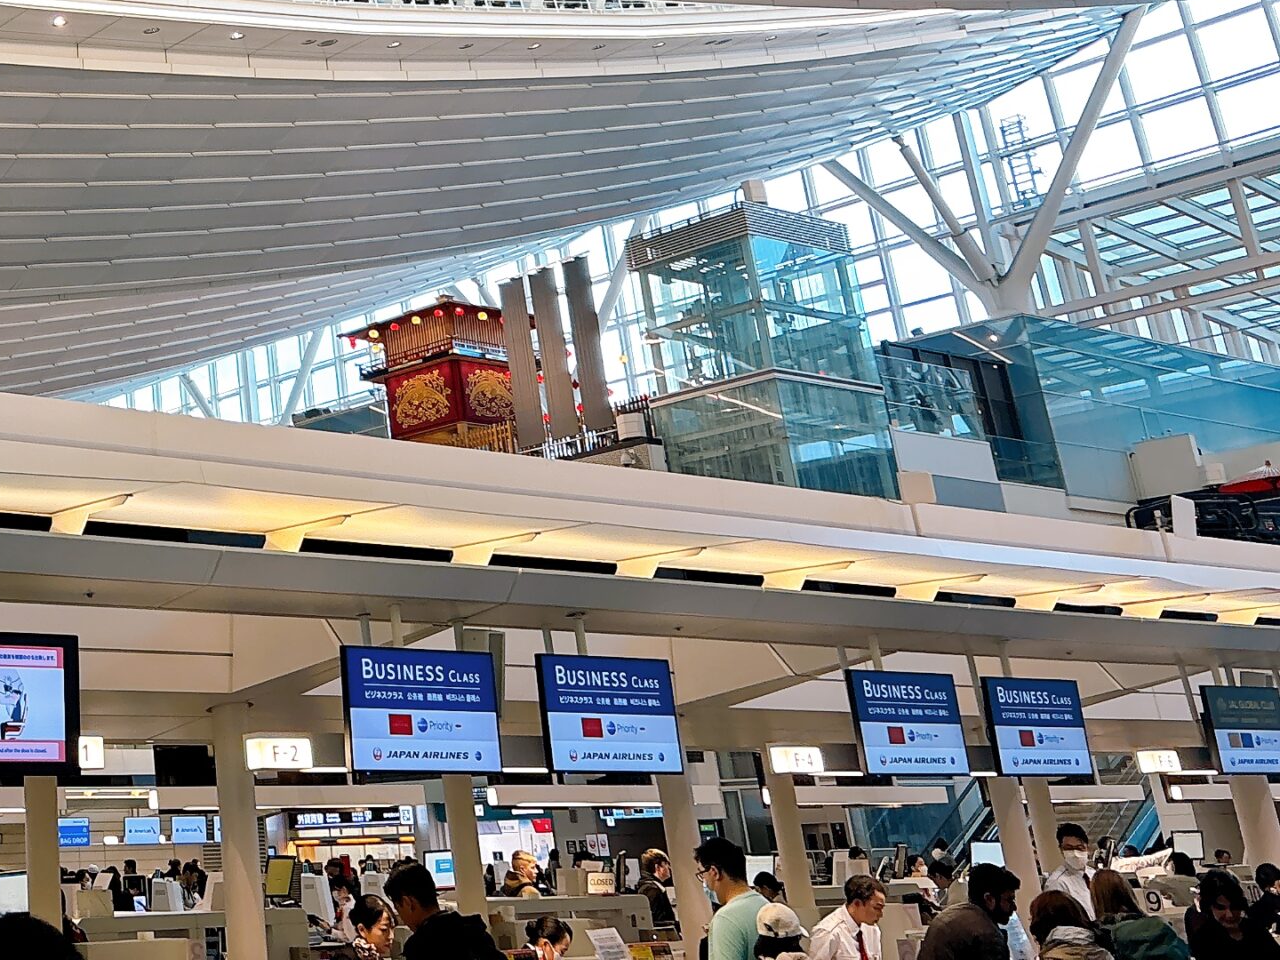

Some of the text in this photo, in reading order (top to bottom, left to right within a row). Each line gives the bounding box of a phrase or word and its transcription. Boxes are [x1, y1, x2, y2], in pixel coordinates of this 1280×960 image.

[361, 658, 480, 684] BUSINESS CLASS
[555, 665, 660, 689] BUSINESS CLASS
[365, 691, 404, 700] ビジネスクラス
[863, 680, 947, 700] BUSINESS CLASS
[996, 686, 1072, 705] BUSINESS CLASS
[429, 721, 454, 732] Priority
[273, 745, 299, 762] F-2
[386, 750, 469, 760] JAPAN AIRLINES
[581, 751, 654, 761] JAPAN AIRLINES
[590, 878, 614, 886] CLOSED
[1146, 891, 1160, 912] 9
